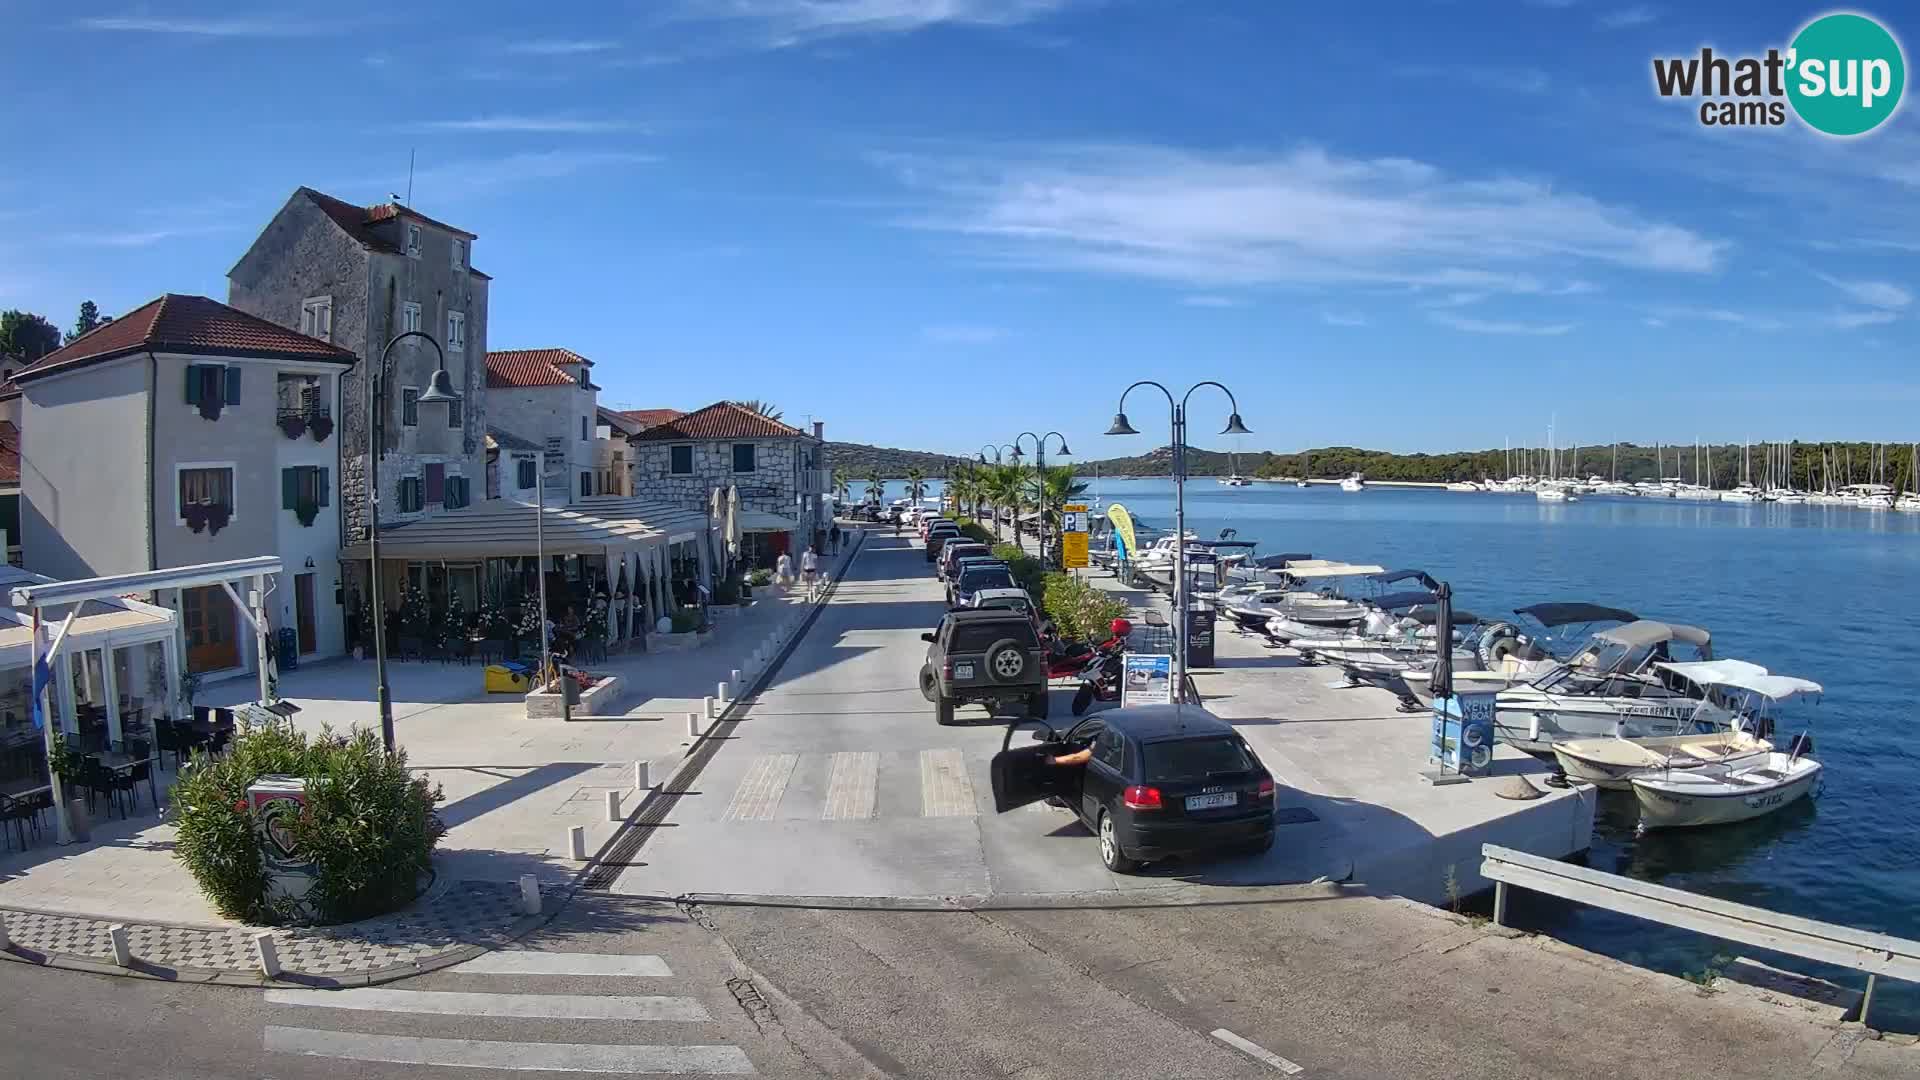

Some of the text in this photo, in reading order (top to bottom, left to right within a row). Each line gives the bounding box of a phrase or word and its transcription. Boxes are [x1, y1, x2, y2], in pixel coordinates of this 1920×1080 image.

[1065, 515, 1075, 530] P
[1463, 701, 1494, 713] RENT
[1650, 706, 1669, 717] RENT
[1463, 711, 1494, 721] A BOAT
